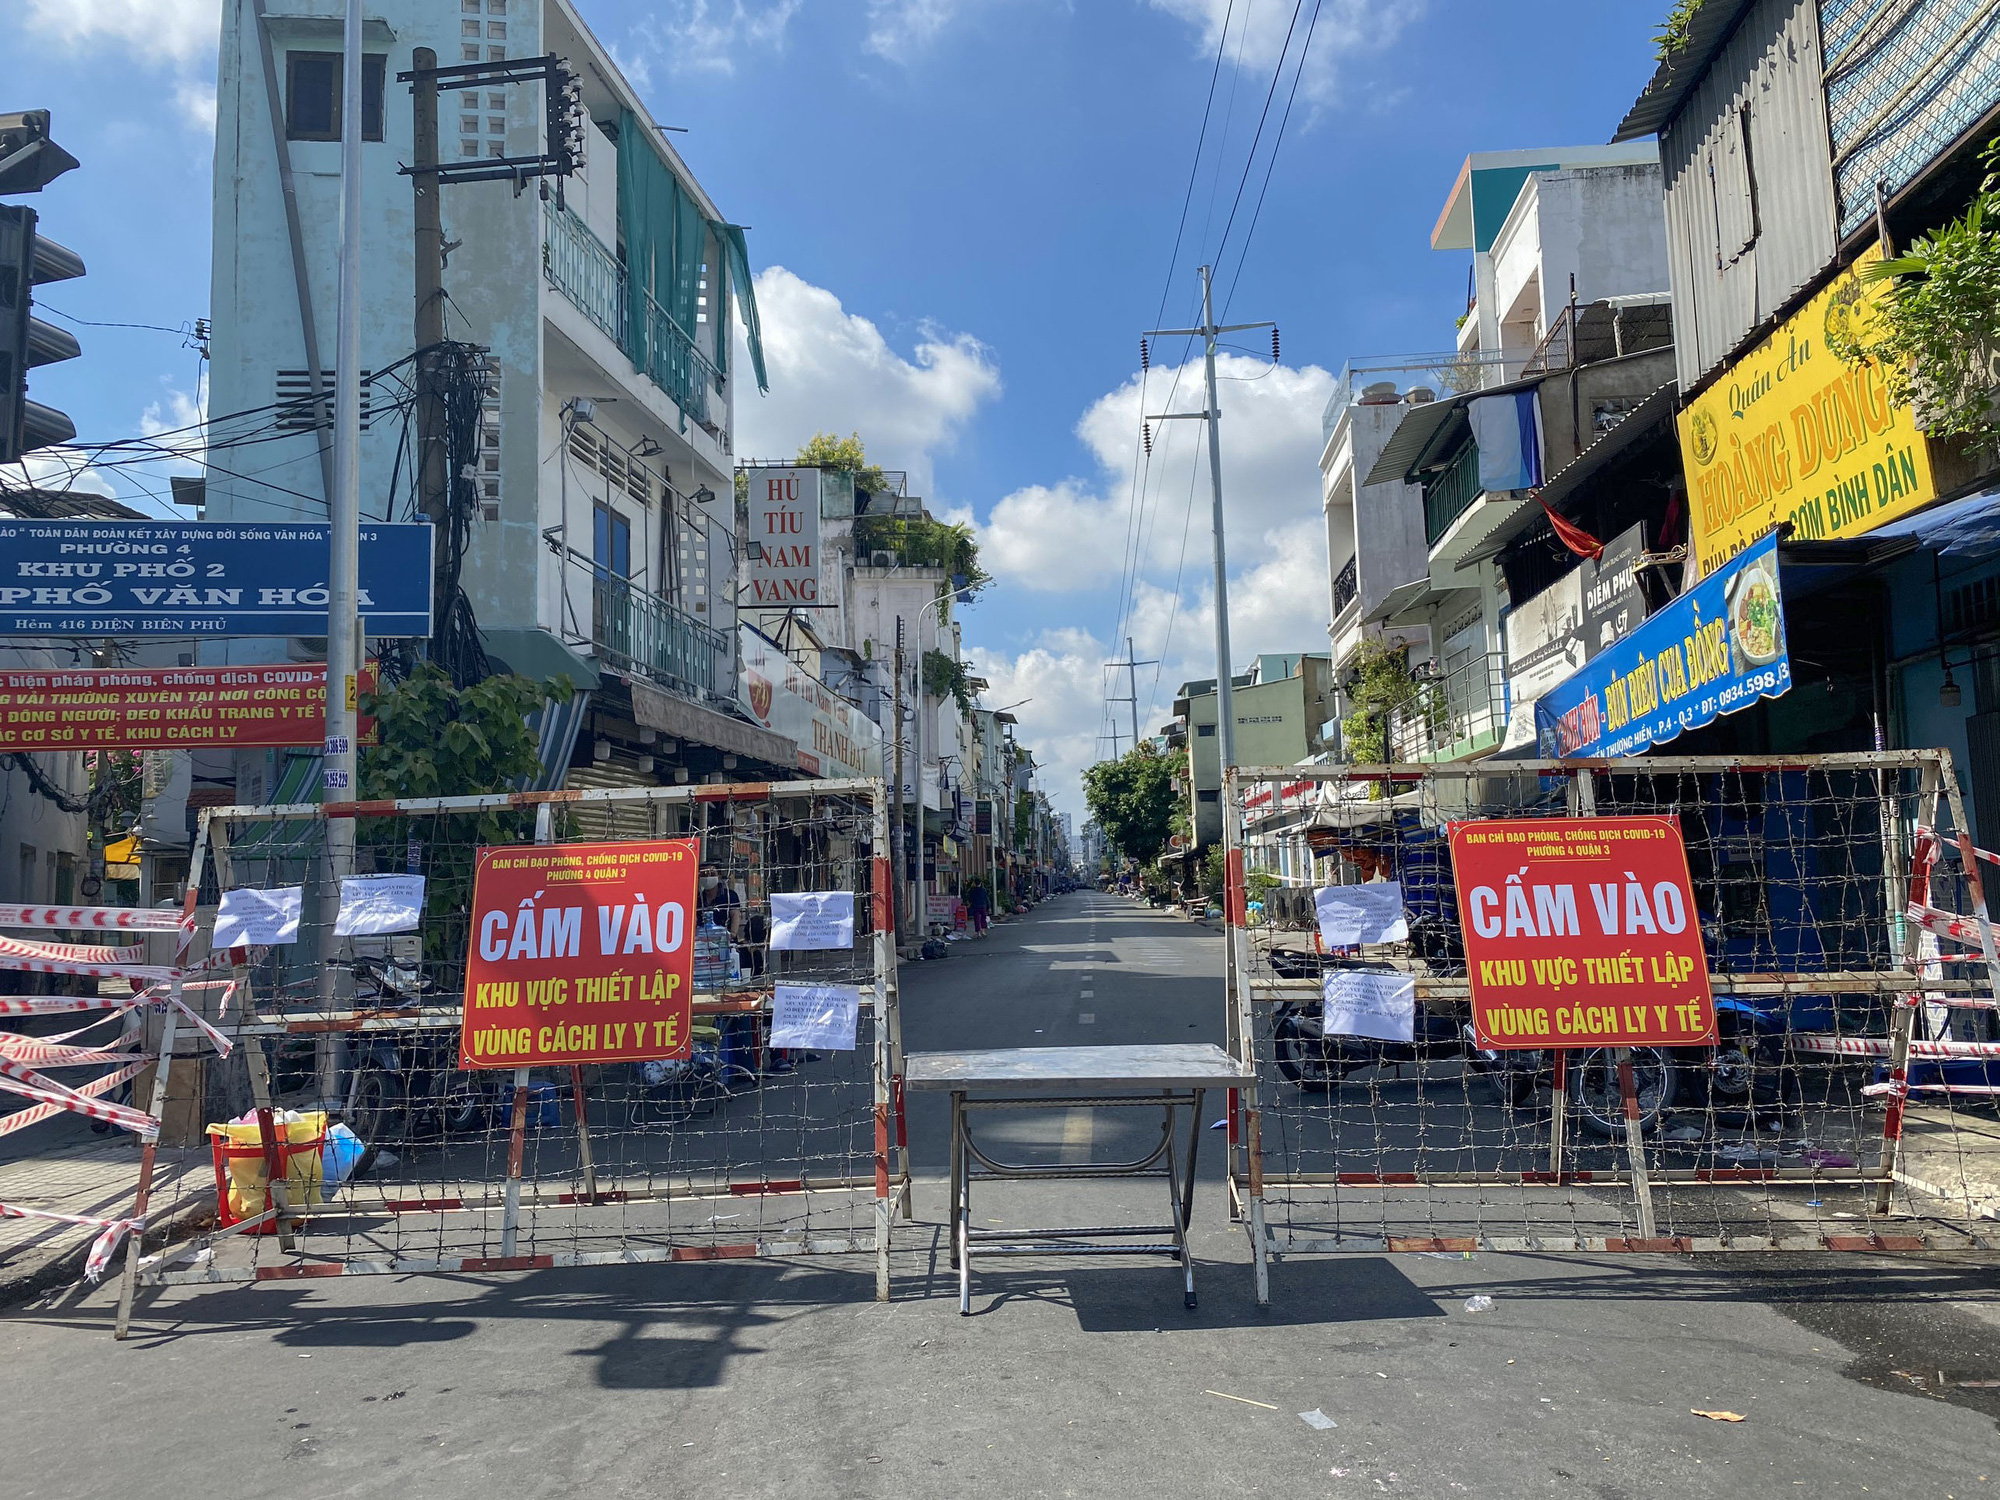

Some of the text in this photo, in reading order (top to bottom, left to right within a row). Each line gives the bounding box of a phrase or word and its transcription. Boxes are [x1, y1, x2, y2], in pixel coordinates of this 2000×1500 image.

[1728, 327, 1812, 420] Quán Ăn
[1697, 354, 1895, 537] HOÀNG DUNG
[767, 472, 799, 501] HỦ
[1825, 470, 1872, 532] BÌNH
[1872, 442, 1918, 508] DÂN
[764, 506, 803, 534] TÍU
[30, 528, 61, 538] TOÀN
[64, 528, 88, 538] DÂN
[93, 527, 125, 538] ĐOÀN
[128, 527, 151, 539] KẾT
[155, 529, 177, 539] XÂY
[182, 529, 213, 541] DỰNG
[216, 529, 236, 540] ĐỜI
[240, 528, 271, 540] SỐNG
[274, 529, 297, 540] VĂN
[299, 530, 323, 541] HÓA
[370, 533, 378, 541] 3
[60, 540, 191, 554] PHƯỜNG 4
[757, 545, 810, 568] NAM
[17, 556, 225, 577] KHU PHỐ 2
[0, 580, 113, 605] PHỐ
[130, 583, 244, 605] VĂN
[752, 578, 817, 601] VANG
[15, 616, 228, 632] Hẻm 416 ĐIỆN BIÊN PHỦ
[9, 675, 47, 689] biện
[52, 674, 94, 688] pháp
[100, 674, 158, 688] phòng,
[163, 671, 215, 686] chống
[221, 672, 258, 686] dịch
[263, 671, 328, 684] COVID-1
[1579, 685, 1601, 746] BÚN
[1605, 669, 1630, 733] BÚN
[1658, 644, 1688, 704] CUA
[1684, 598, 1730, 690] ĐỒNG
[16, 690, 45, 704] VẢI
[51, 690, 120, 704] THƯỜNG
[125, 690, 183, 703] XUYÊN
[187, 691, 215, 706] TẠI
[219, 689, 249, 701] NƠI
[253, 688, 300, 700] CÔNG
[305, 688, 327, 702] CỘ
[8, 709, 56, 723] ĐÔNG
[61, 709, 121, 722] NGƯỜI;
[126, 709, 161, 721] ĐEO
[165, 704, 213, 720] KHẨU
[218, 707, 275, 719] TRANG
[280, 707, 290, 719] Y
[296, 703, 316, 718] TẾ
[22, 728, 46, 741] CƠ
[51, 725, 74, 741] SỞ
[79, 729, 92, 741] Y
[95, 725, 121, 741] TẾ,
[126, 727, 161, 739] KHU
[167, 725, 214, 739] CÁCH
[219, 726, 238, 738] LY
[1606, 732, 1633, 756] THƯỢNG
[1634, 723, 1652, 744] HIỀN
[1658, 717, 1672, 735] P.4
[1679, 707, 1693, 727] Q.3
[1701, 697, 1718, 714] ĐT:
[812, 718, 848, 764] THÀNH
[1466, 827, 1665, 844] BAN CHỈ ĐẠO PHÒNG, CHỐNG DỊCH COVID-19
[492, 851, 683, 869] BAN CHỈ ĐẠO PHÒNG, CHỐNG DỊCH COVID-19
[1527, 843, 1610, 857] PHƯỜNG 4 QUẬN 3
[546, 868, 627, 881] PHƯỜNG 4 QUẬN 3
[1469, 866, 1580, 938] CẤM
[1589, 871, 1686, 935] VÀO
[479, 890, 583, 962] CẤM
[598, 893, 684, 956] VÀO
[1479, 948, 1694, 991] KHU VỰC THIẾT LẬP
[475, 968, 680, 1011] KHU VỰC THIẾT LẬP
[1486, 996, 1704, 1035] VÙNG CÁCH LY Y TẾ
[473, 1012, 680, 1056] VÙNG CÁCH LY Y TẾ
